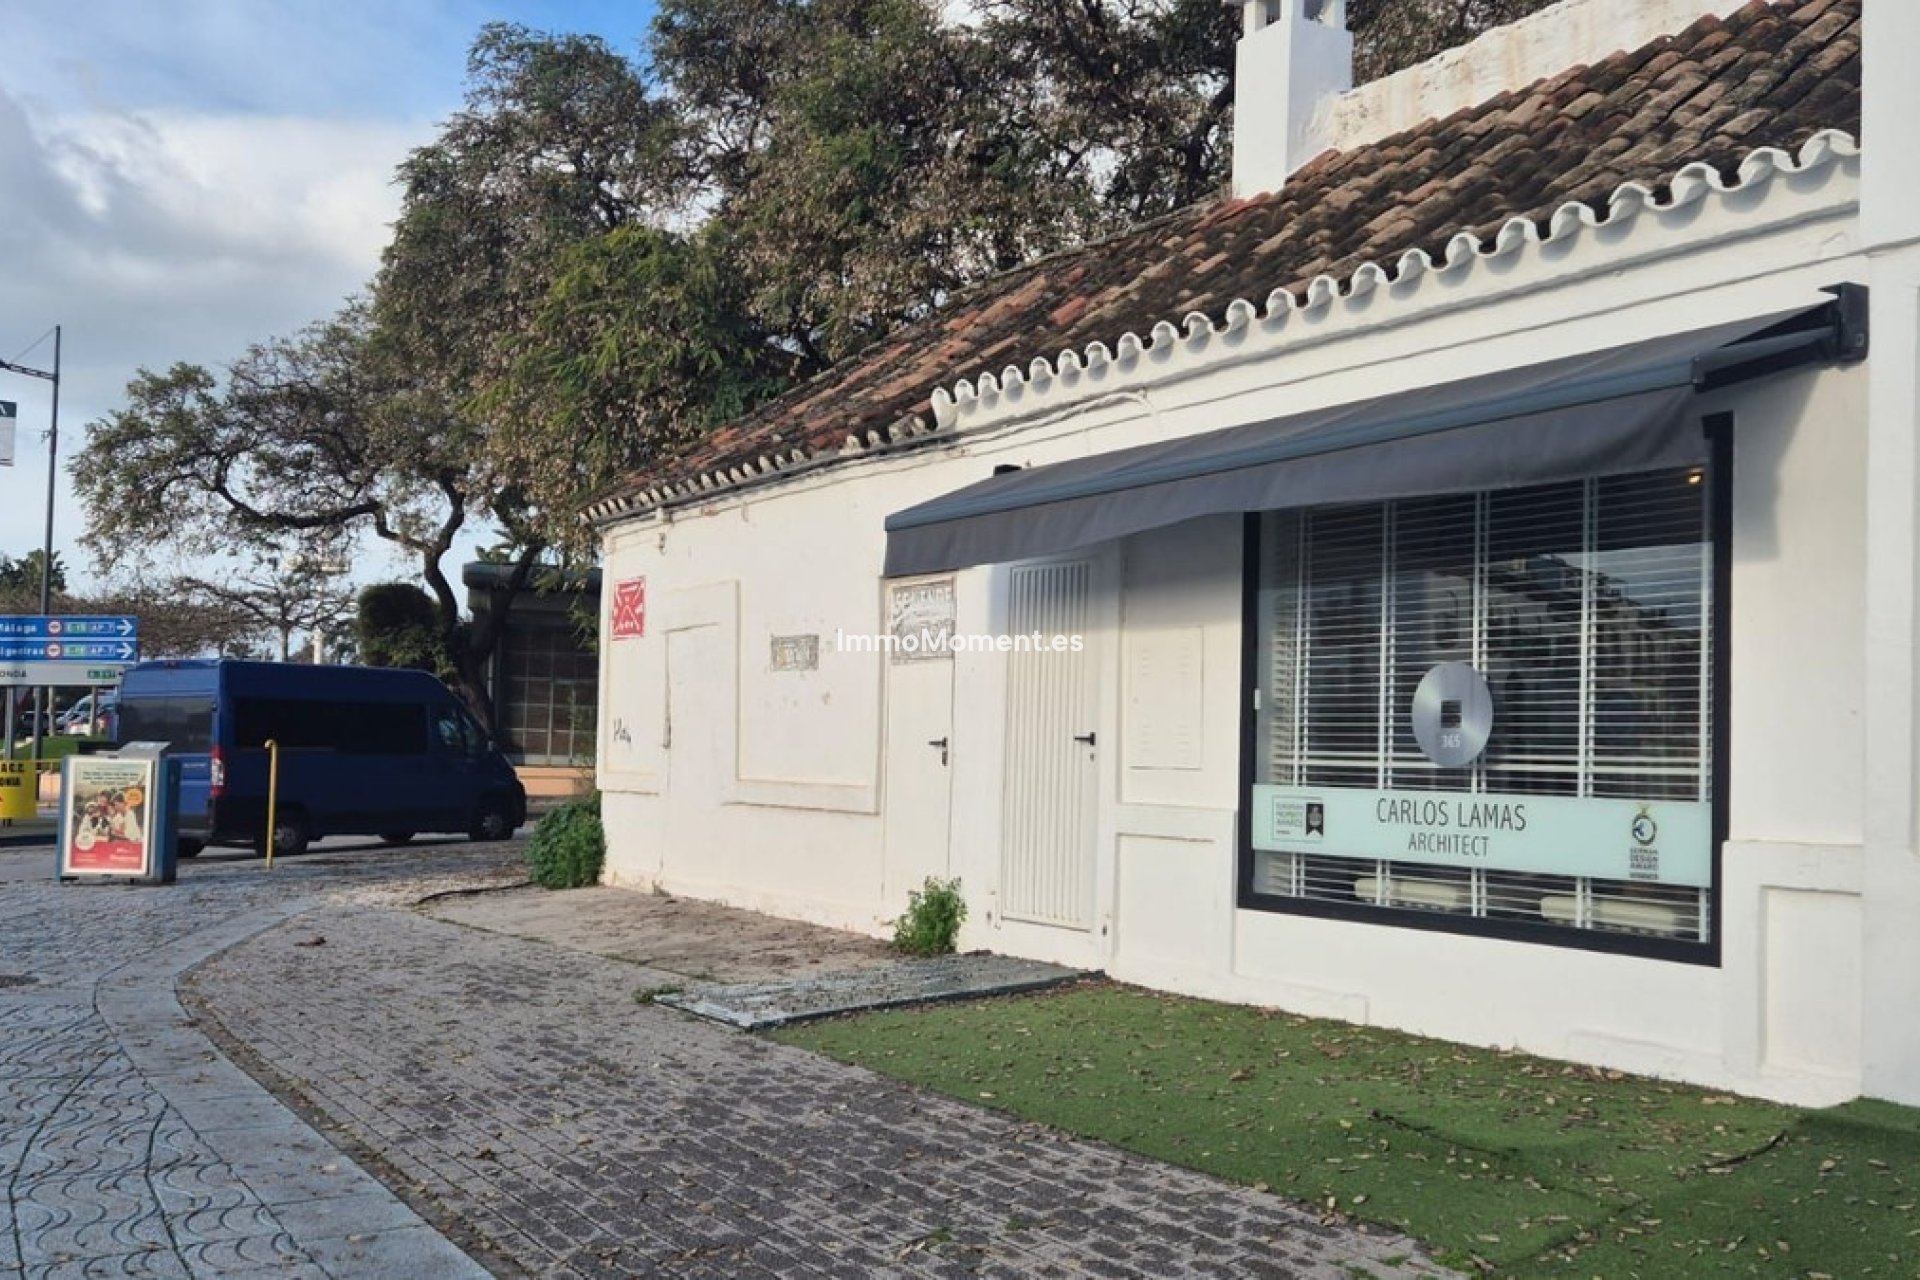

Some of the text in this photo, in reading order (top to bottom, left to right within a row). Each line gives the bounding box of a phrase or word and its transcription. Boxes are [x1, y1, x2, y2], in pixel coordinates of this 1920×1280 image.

[1376, 797, 1527, 831] CARLOS LAMAS
[1408, 832, 1490, 857] ARCHITECT
